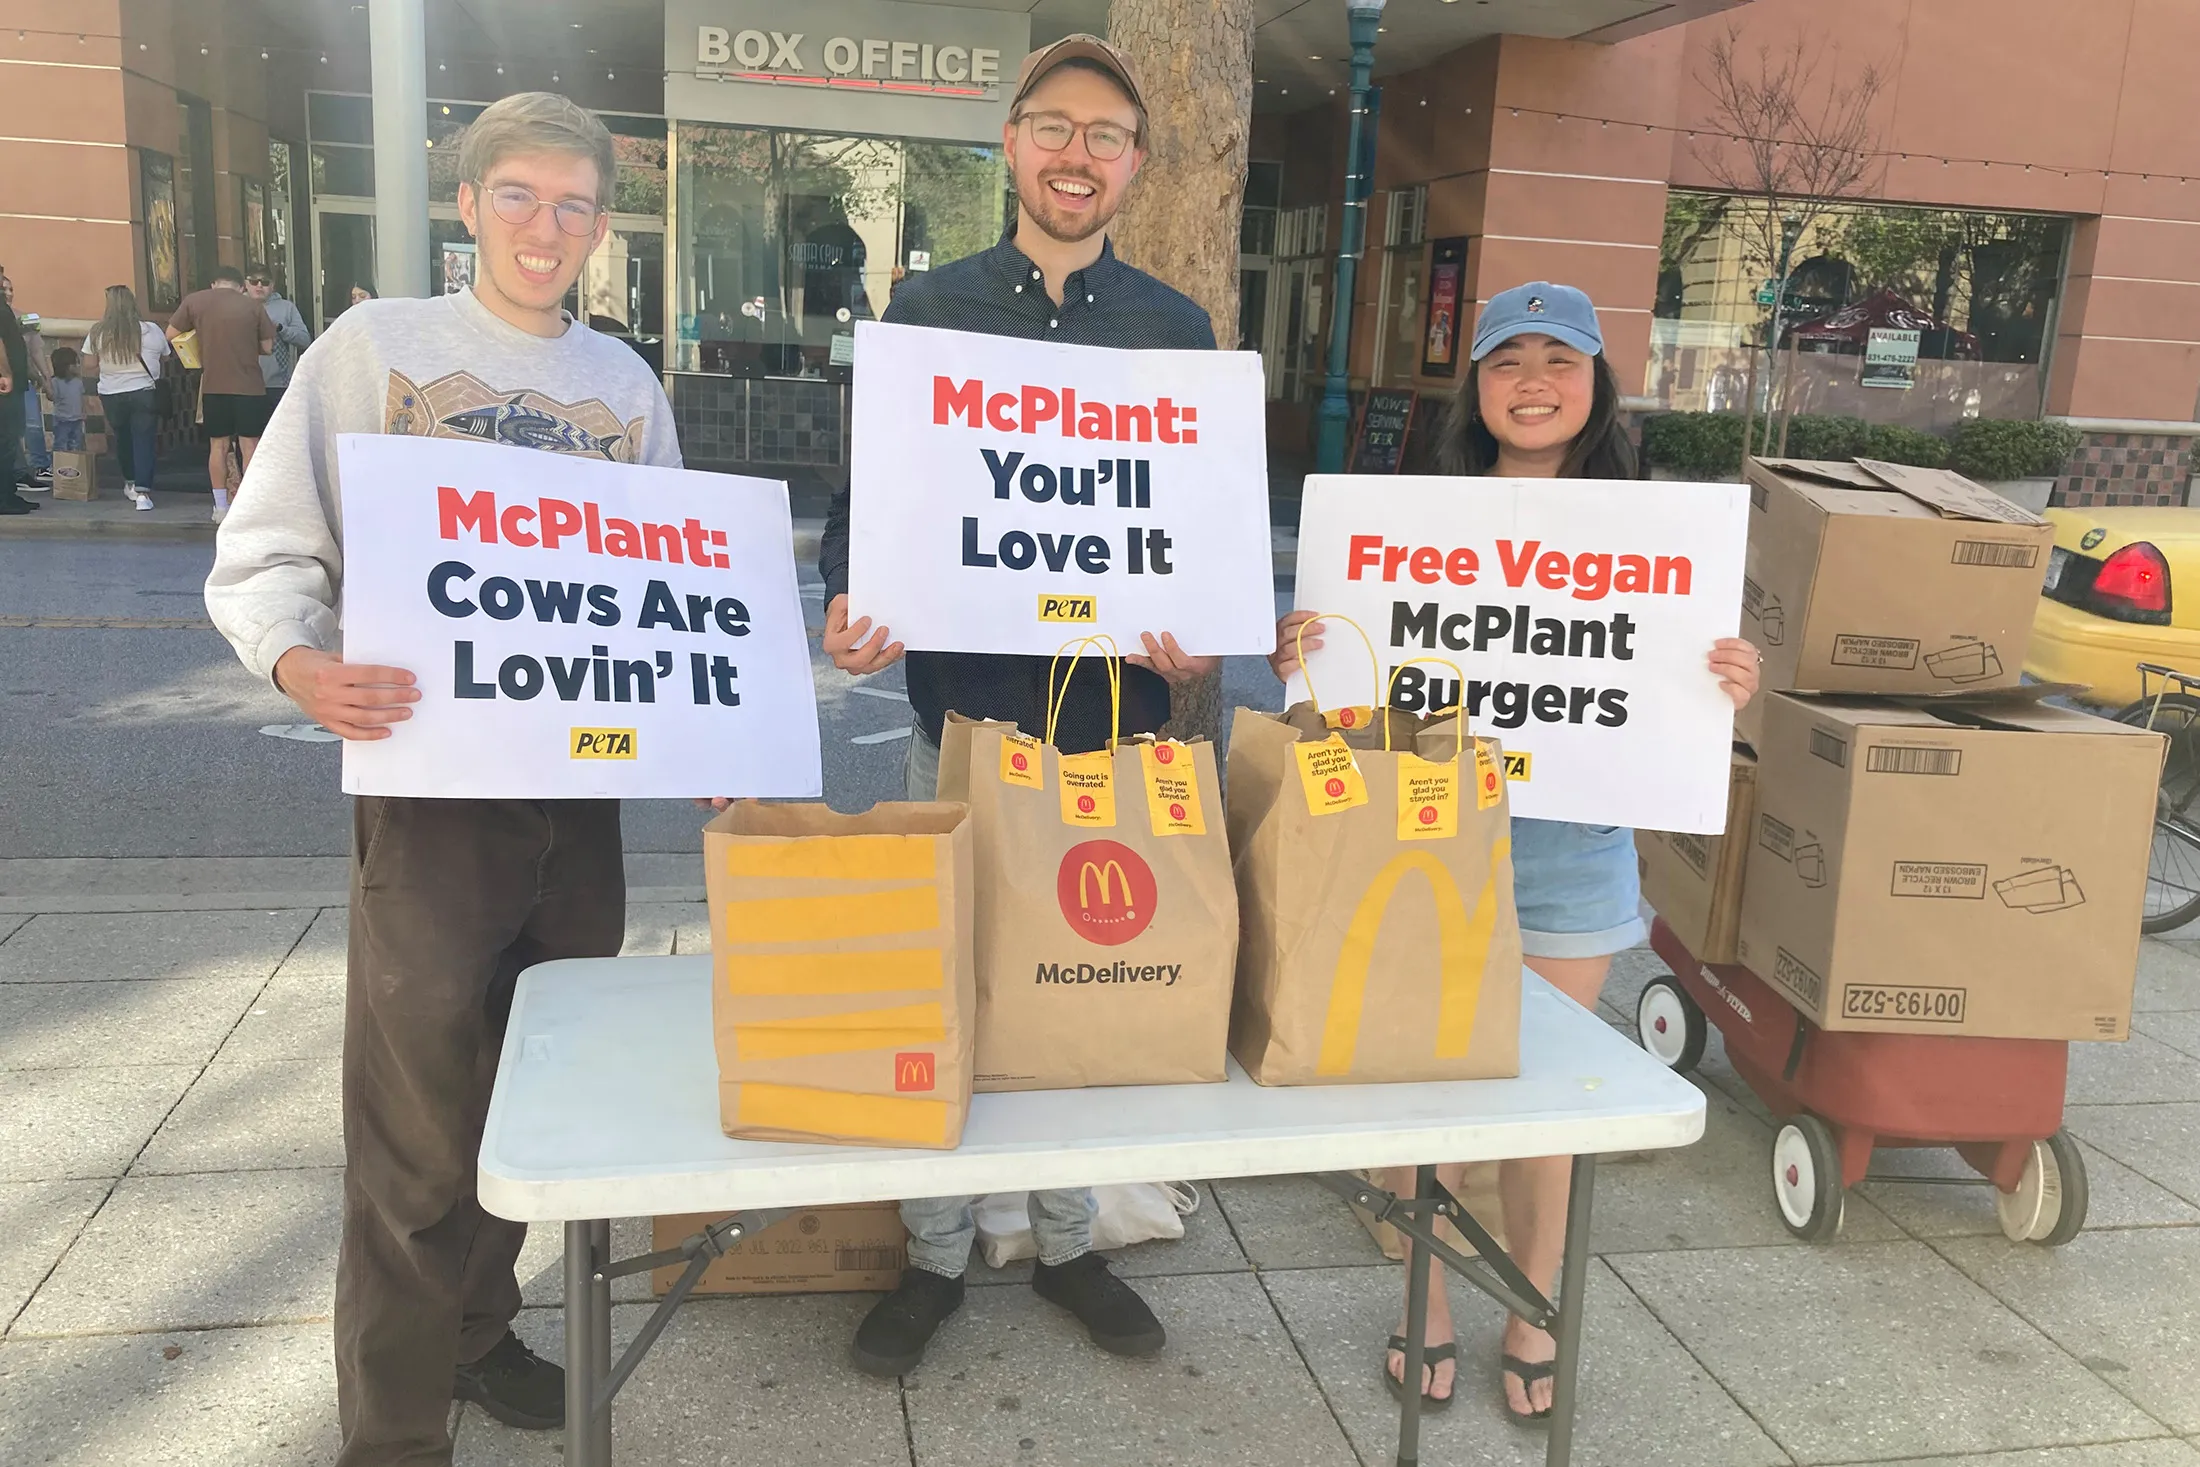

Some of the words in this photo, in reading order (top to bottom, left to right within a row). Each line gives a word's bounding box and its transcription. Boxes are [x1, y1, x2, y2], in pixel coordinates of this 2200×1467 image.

[697, 25, 804, 70] BOX
[823, 37, 1000, 83] OFFICE
[788, 243, 817, 262] SANTA
[819, 244, 844, 264] CRUZ
[1871, 332, 1919, 342] AVAILABLE
[1372, 396, 1401, 410] NOW
[933, 375, 1198, 444] McPlant:
[980, 448, 1151, 508] You'll
[437, 486, 731, 569] McPlant:
[961, 516, 1111, 575] Love
[1127, 527, 1173, 575] It
[1347, 534, 1479, 586] Free
[1495, 539, 1692, 601] Vegan
[427, 560, 622, 627] Cows
[637, 579, 751, 637] Are
[1390, 601, 1635, 661] McPlant
[1841, 638, 1869, 647] NAPKIN
[1871, 640, 1915, 649] EMBOSSED
[1843, 647, 1878, 656] RECYCLE
[1880, 649, 1909, 658] BROWN
[1870, 656, 1877, 664] X
[454, 640, 673, 704] Lovin'
[690, 652, 740, 707] It
[1388, 666, 1629, 729] Burgers
[1332, 747, 1348, 756] you
[1313, 758, 1330, 769] glad
[1331, 756, 1346, 765] you
[1503, 757, 1526, 776] TA
[1312, 765, 1339, 776] stayed
[1339, 762, 1351, 771] in?
[1063, 770, 1085, 781] Going
[1066, 780, 1106, 788] overrated.
[1434, 778, 1449, 786] you
[1412, 786, 1430, 795] glad
[1431, 786, 1446, 794] you
[1409, 794, 1436, 803] stayed
[1899, 866, 1931, 875] NAPKIN
[1933, 867, 1981, 876] EMBOSSED
[1902, 875, 1942, 884] RECYCLE
[1944, 876, 1976, 885] BROWN
[1923, 885, 1933, 893] 12
[1943, 886, 1952, 894] 13
[1035, 960, 1180, 986] McDelivery
[1847, 989, 1960, 1017] 00193-522
